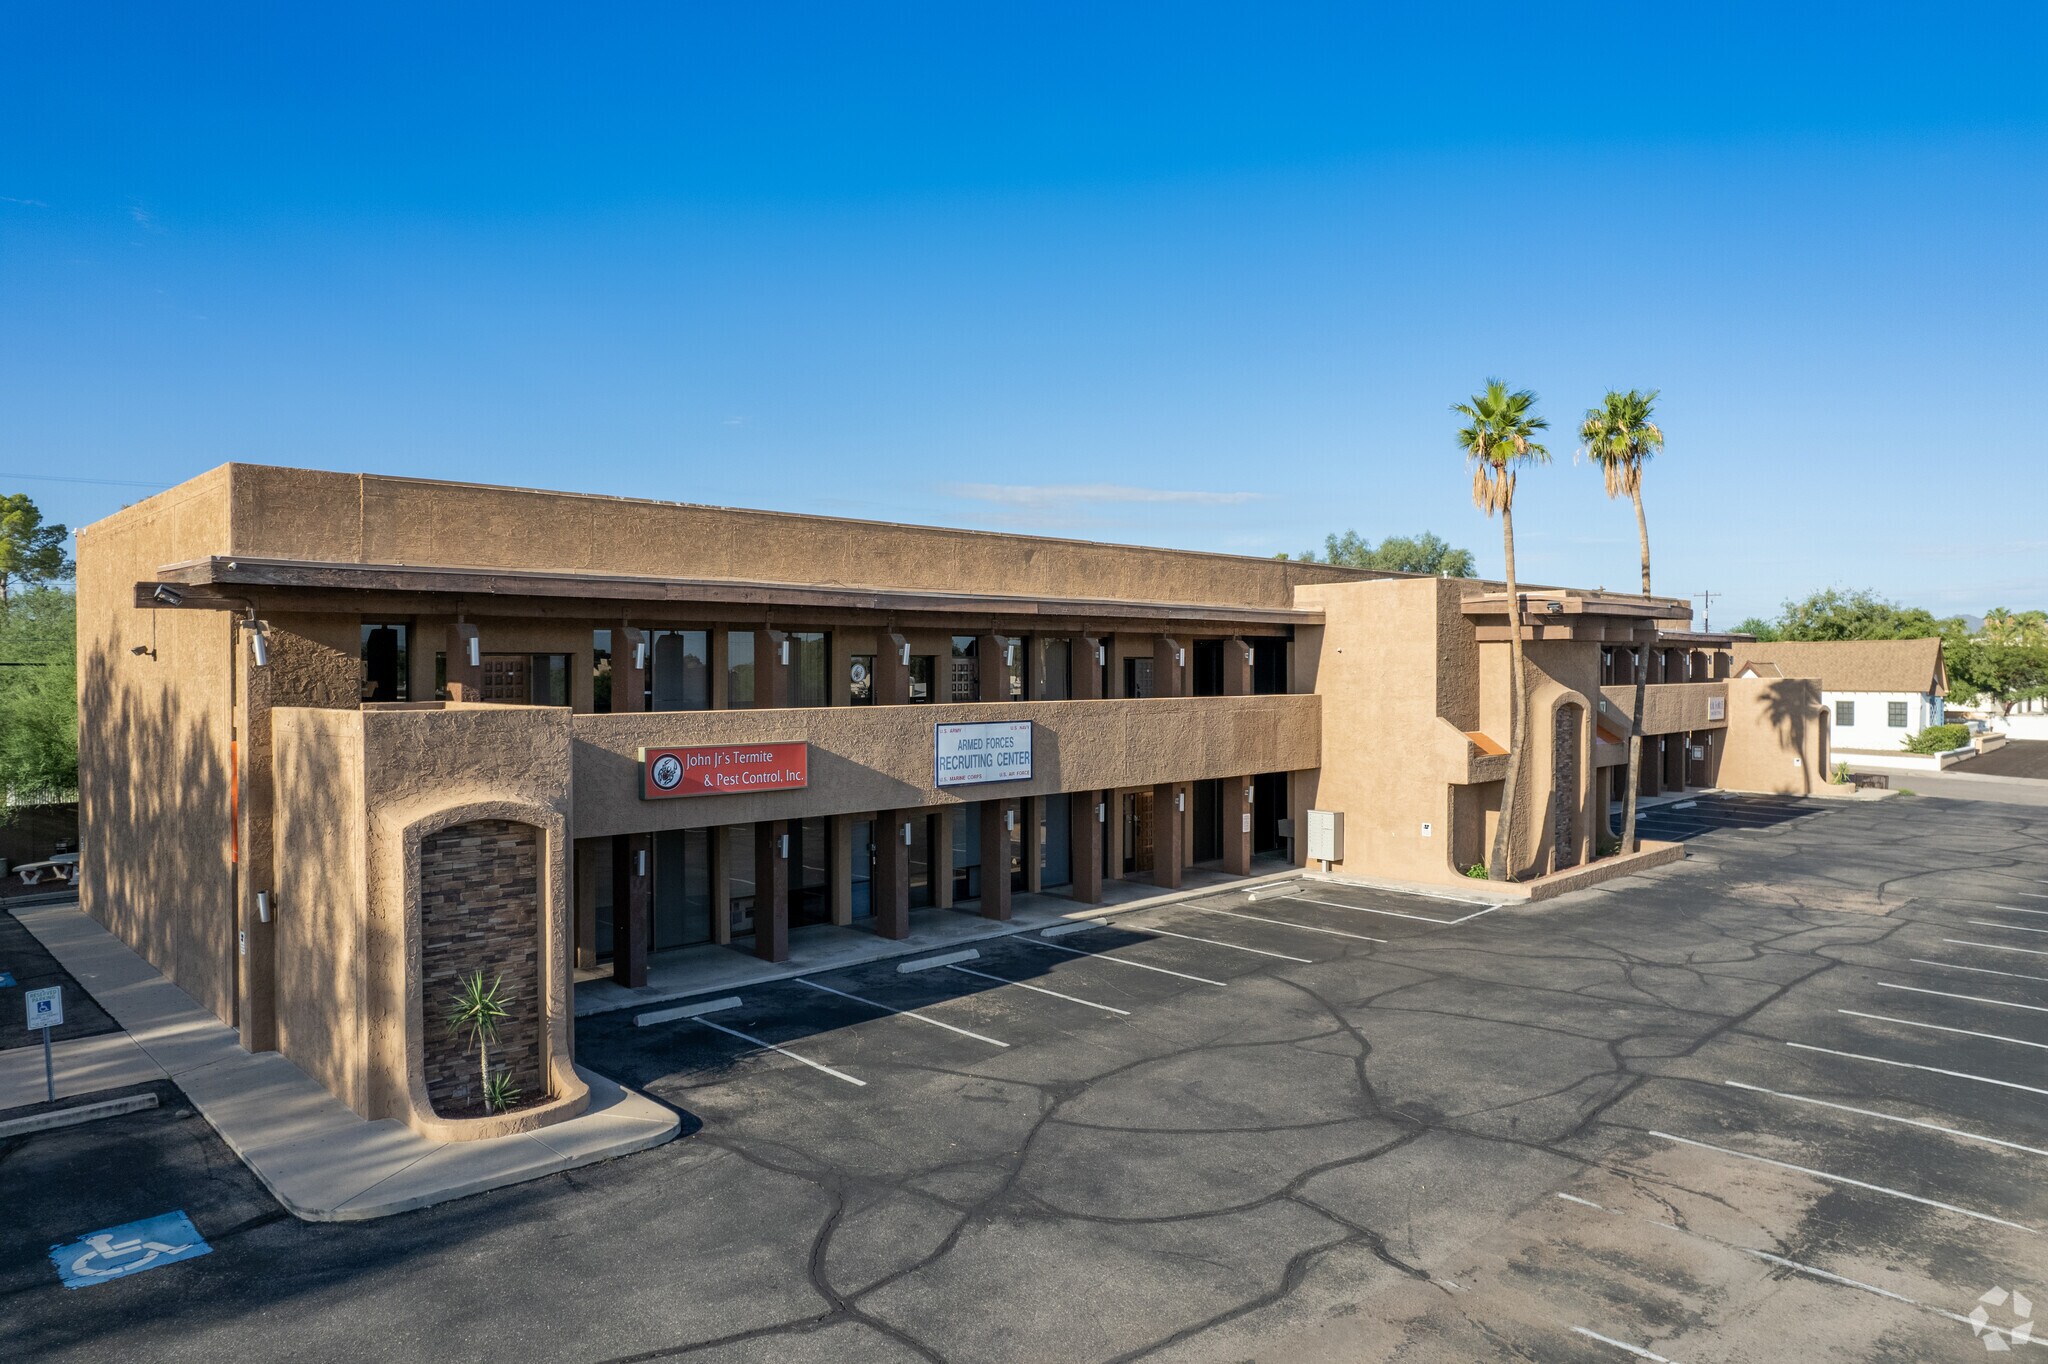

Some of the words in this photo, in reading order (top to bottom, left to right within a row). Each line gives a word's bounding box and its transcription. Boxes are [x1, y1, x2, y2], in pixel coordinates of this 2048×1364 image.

[957, 738, 983, 751] ARMED
[986, 736, 1014, 749] FORCES
[686, 753, 711, 770] John
[733, 750, 773, 765] Termite
[940, 753, 993, 771] RECRUITING
[996, 751, 1030, 767] CENTER
[703, 775, 713, 787] &
[716, 773, 739, 786] Pest
[786, 769, 804, 782] Inc.
